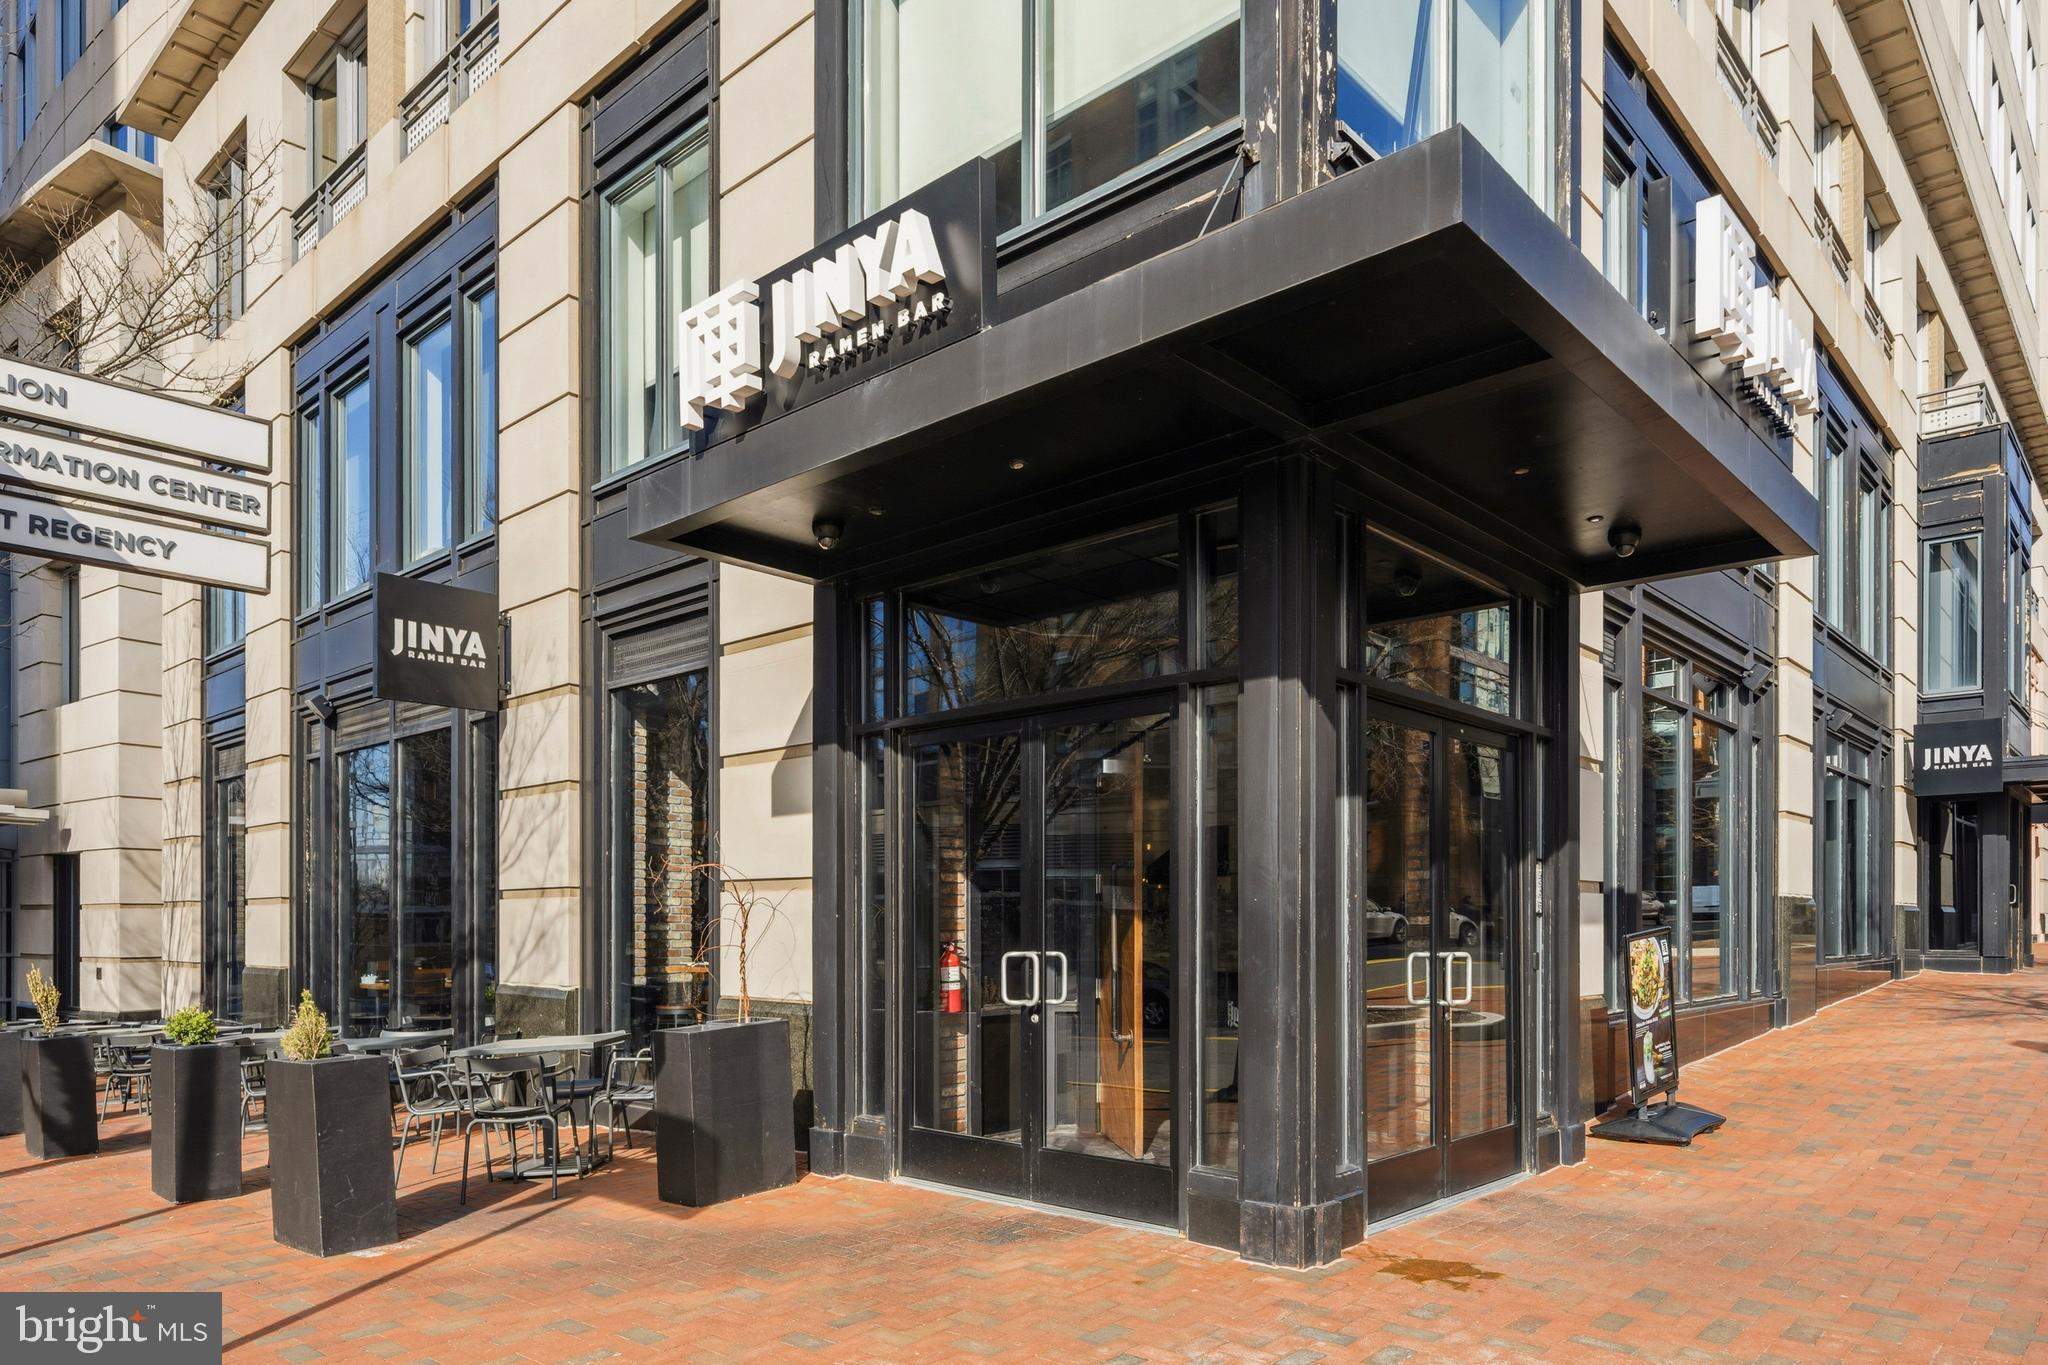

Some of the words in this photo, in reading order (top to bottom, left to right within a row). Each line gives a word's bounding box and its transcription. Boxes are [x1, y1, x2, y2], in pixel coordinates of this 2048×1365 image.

[769, 208, 946, 379] JINYA
[808, 321, 885, 369] RAMEN
[897, 292, 953, 327] BAR
[149, 474, 261, 516] CENTER
[28, 513, 177, 560] REGENCY
[391, 618, 487, 659] JINYA
[408, 650, 454, 664] RAMEN
[460, 658, 486, 669] BAR
[1922, 744, 1993, 770] JINYA
